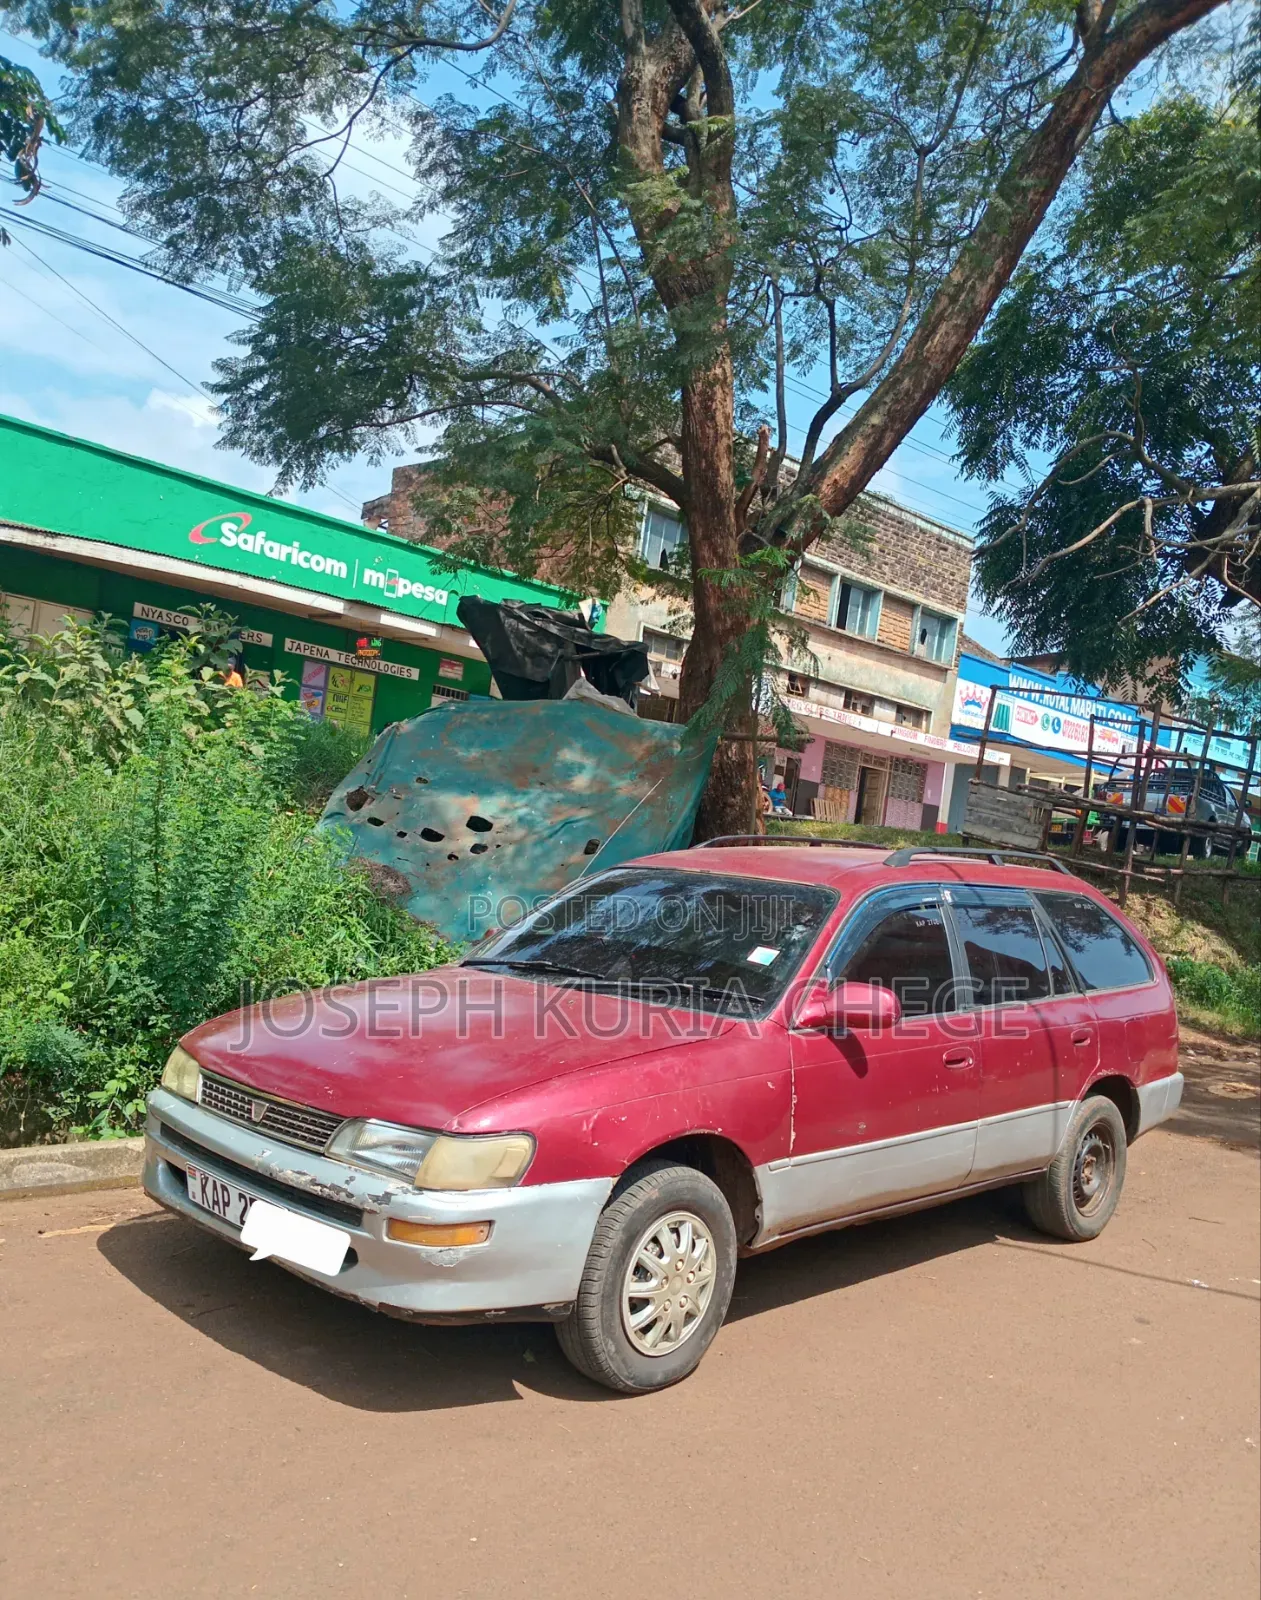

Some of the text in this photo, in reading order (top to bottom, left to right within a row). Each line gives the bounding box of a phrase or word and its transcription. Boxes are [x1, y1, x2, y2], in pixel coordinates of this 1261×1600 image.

[219, 522, 348, 579] Safaricom
[141, 606, 189, 627] NYASCO
[288, 640, 330, 659] JAPENA
[337, 652, 413, 678] TECHNOLOGIES
[200, 1172, 257, 1227] KAP 2
